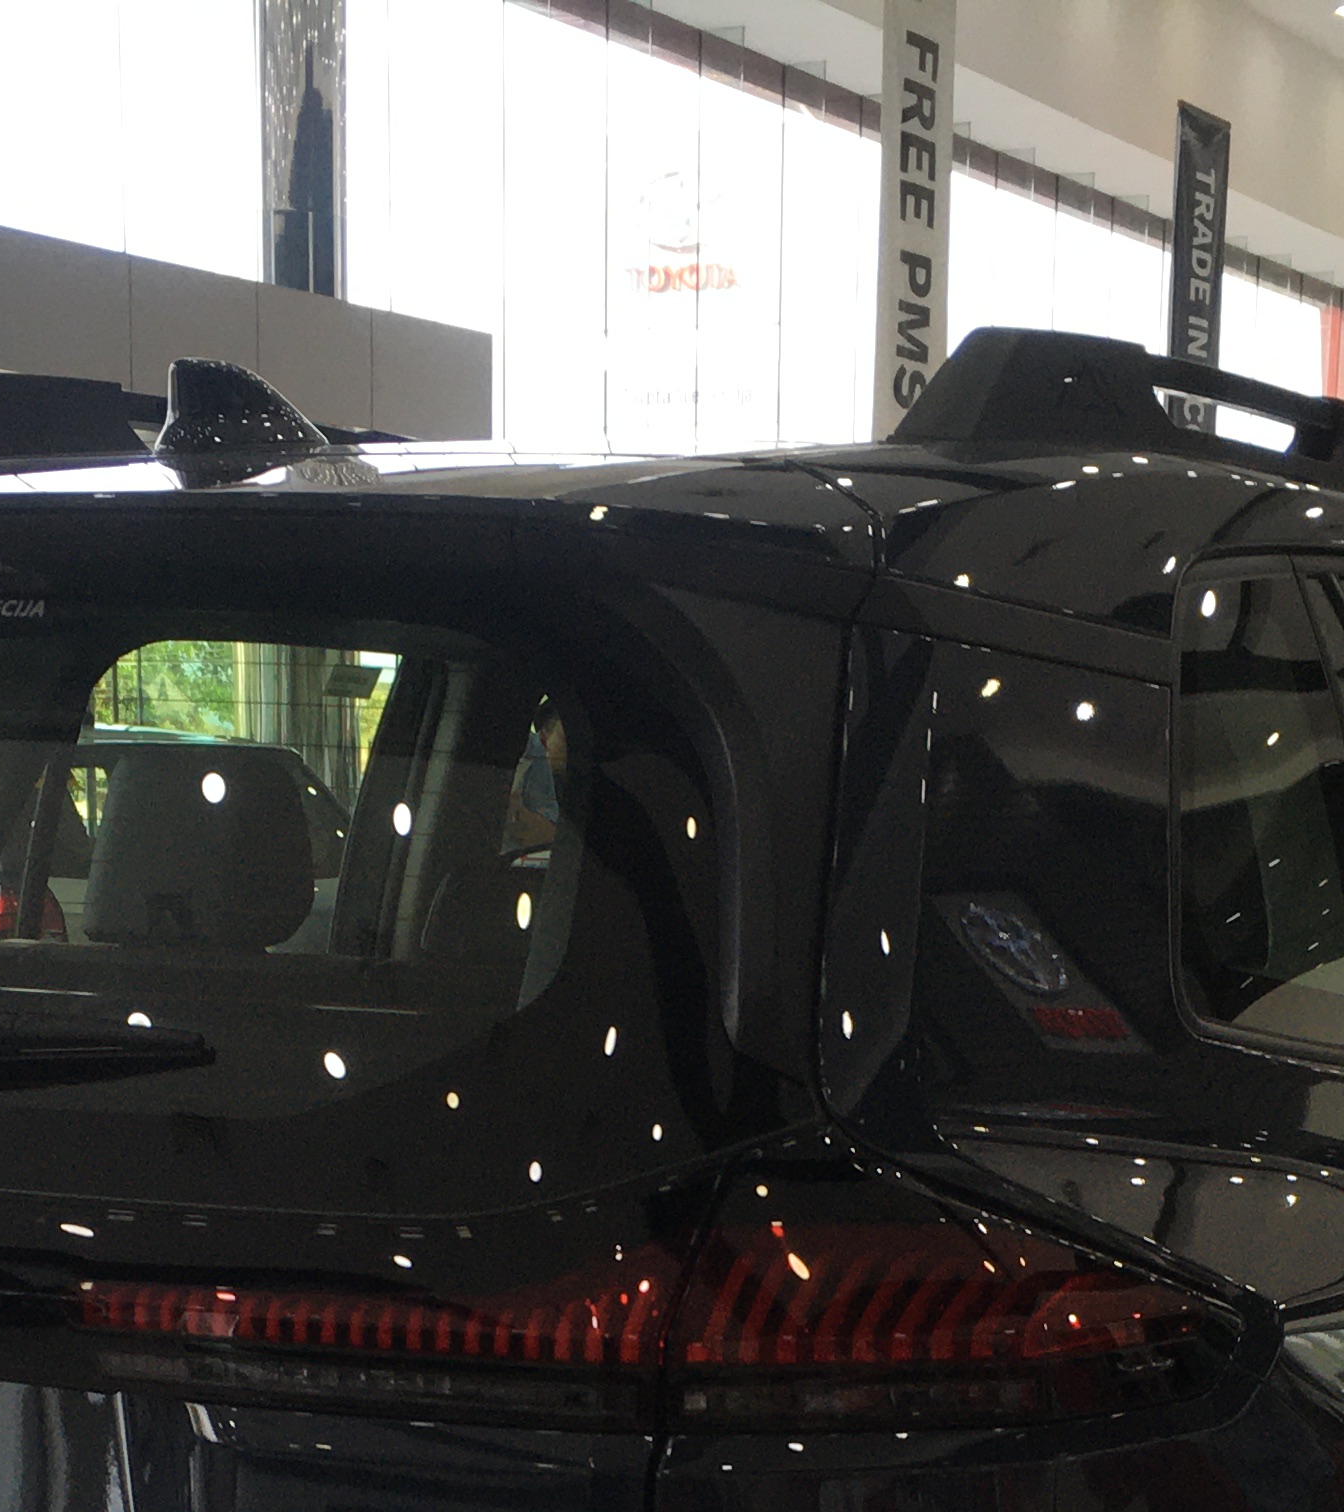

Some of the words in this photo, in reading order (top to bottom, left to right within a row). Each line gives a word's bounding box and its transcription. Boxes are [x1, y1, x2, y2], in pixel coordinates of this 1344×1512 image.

[897, 28, 940, 231] FREE
[1190, 168, 1216, 305] TRADE
[893, 248, 934, 410] PMS
[1186, 316, 1209, 359] IN
